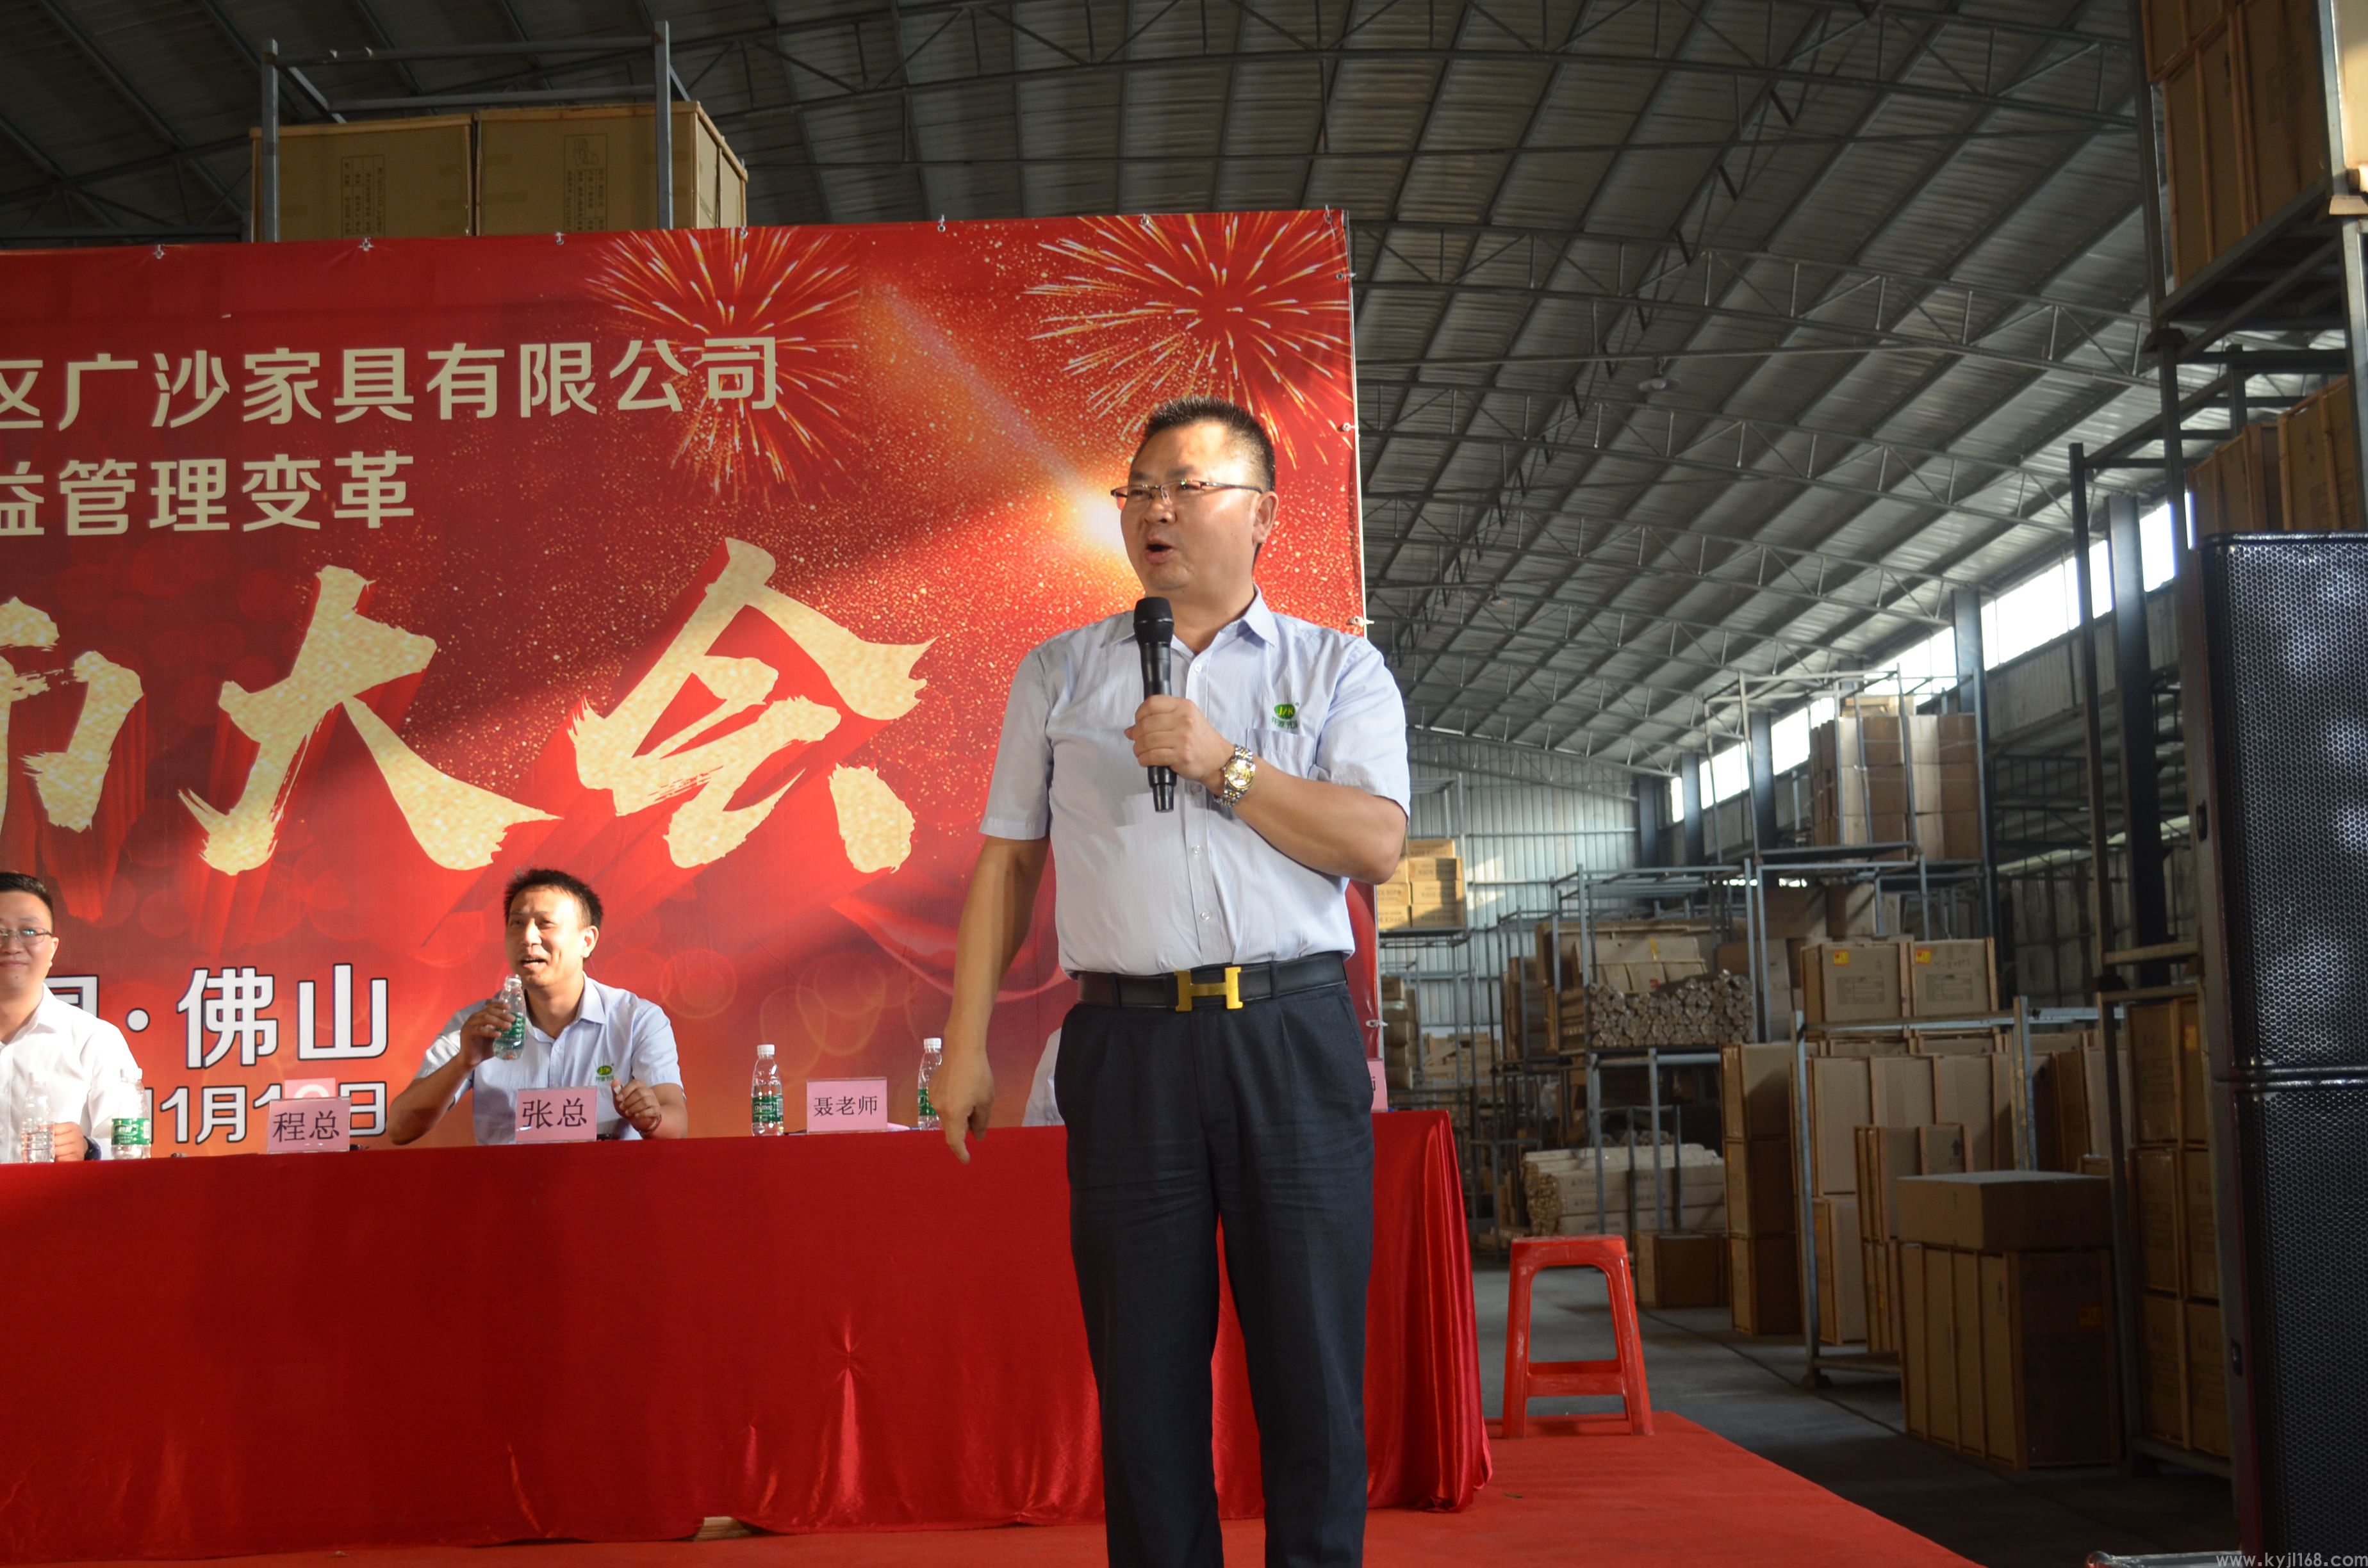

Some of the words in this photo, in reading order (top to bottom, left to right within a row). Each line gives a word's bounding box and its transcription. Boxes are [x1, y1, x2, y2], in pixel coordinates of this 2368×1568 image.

[0, 336, 776, 431] 区广沙家具有限公司
[0, 450, 414, 535] 益管理变革
[522, 1098, 587, 1129] 张总
[814, 1095, 878, 1116] 聂老师
[272, 1110, 340, 1143] 程总
